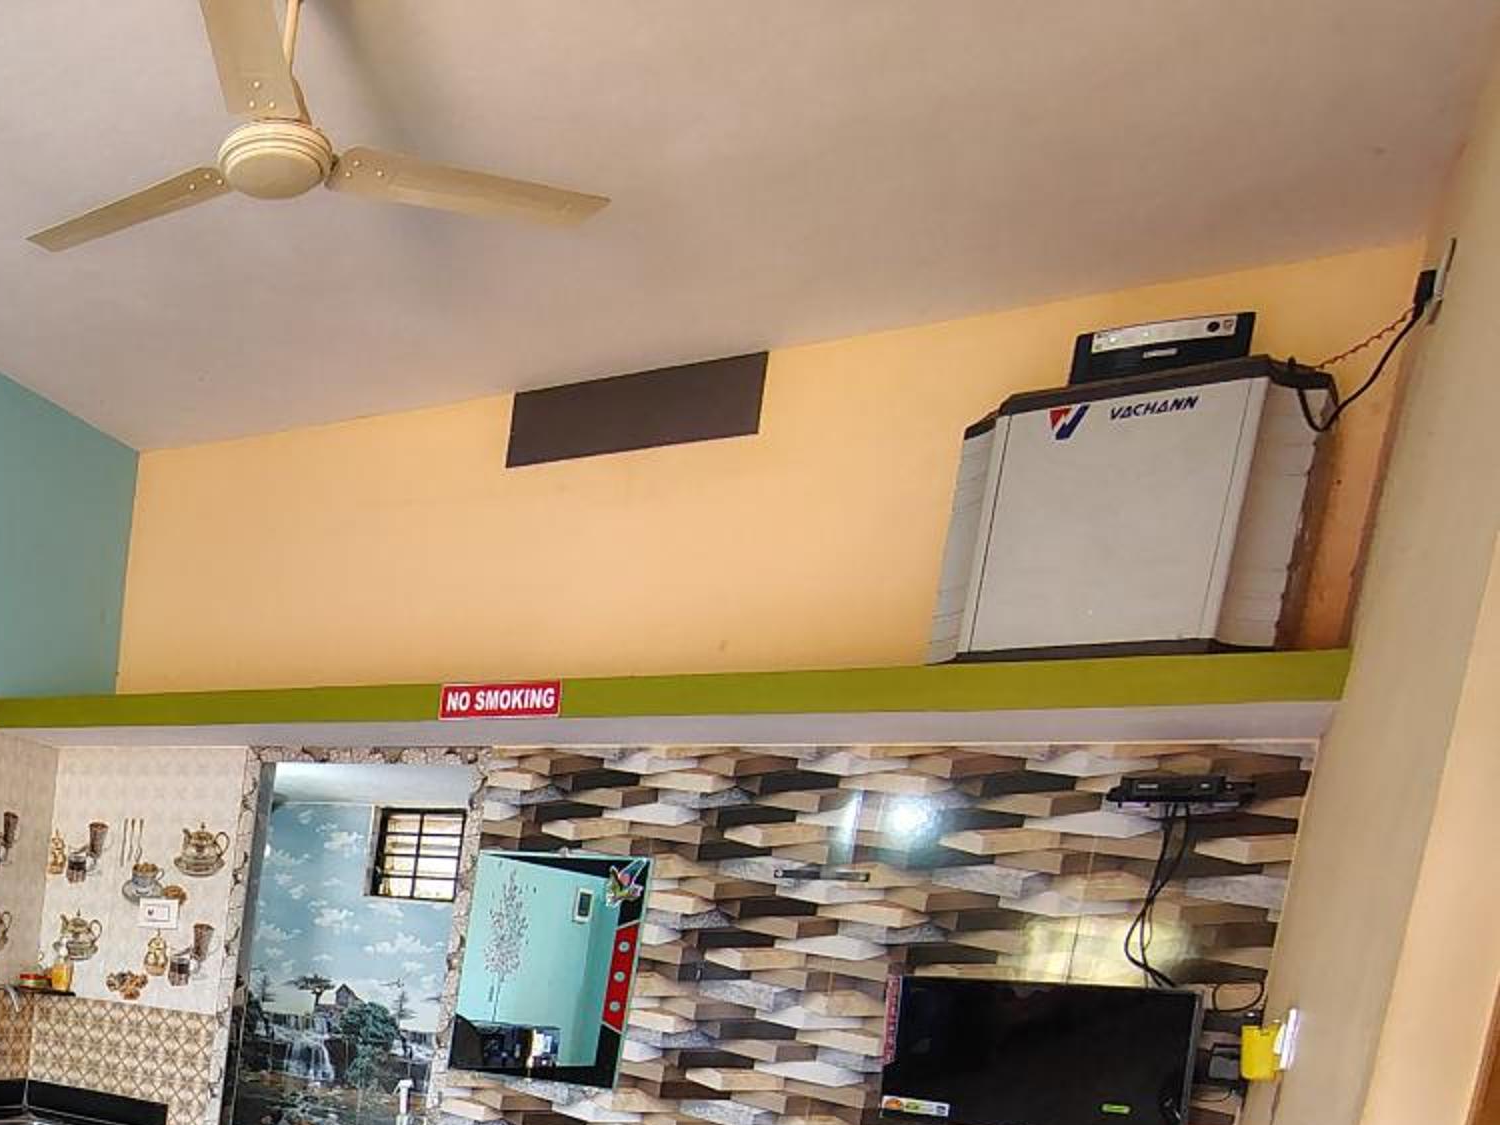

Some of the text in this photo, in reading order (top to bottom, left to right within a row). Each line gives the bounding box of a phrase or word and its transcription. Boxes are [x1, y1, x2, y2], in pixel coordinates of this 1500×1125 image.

[1110, 395, 1199, 420] VACHANN
[446, 687, 556, 712] NO SMOKING
